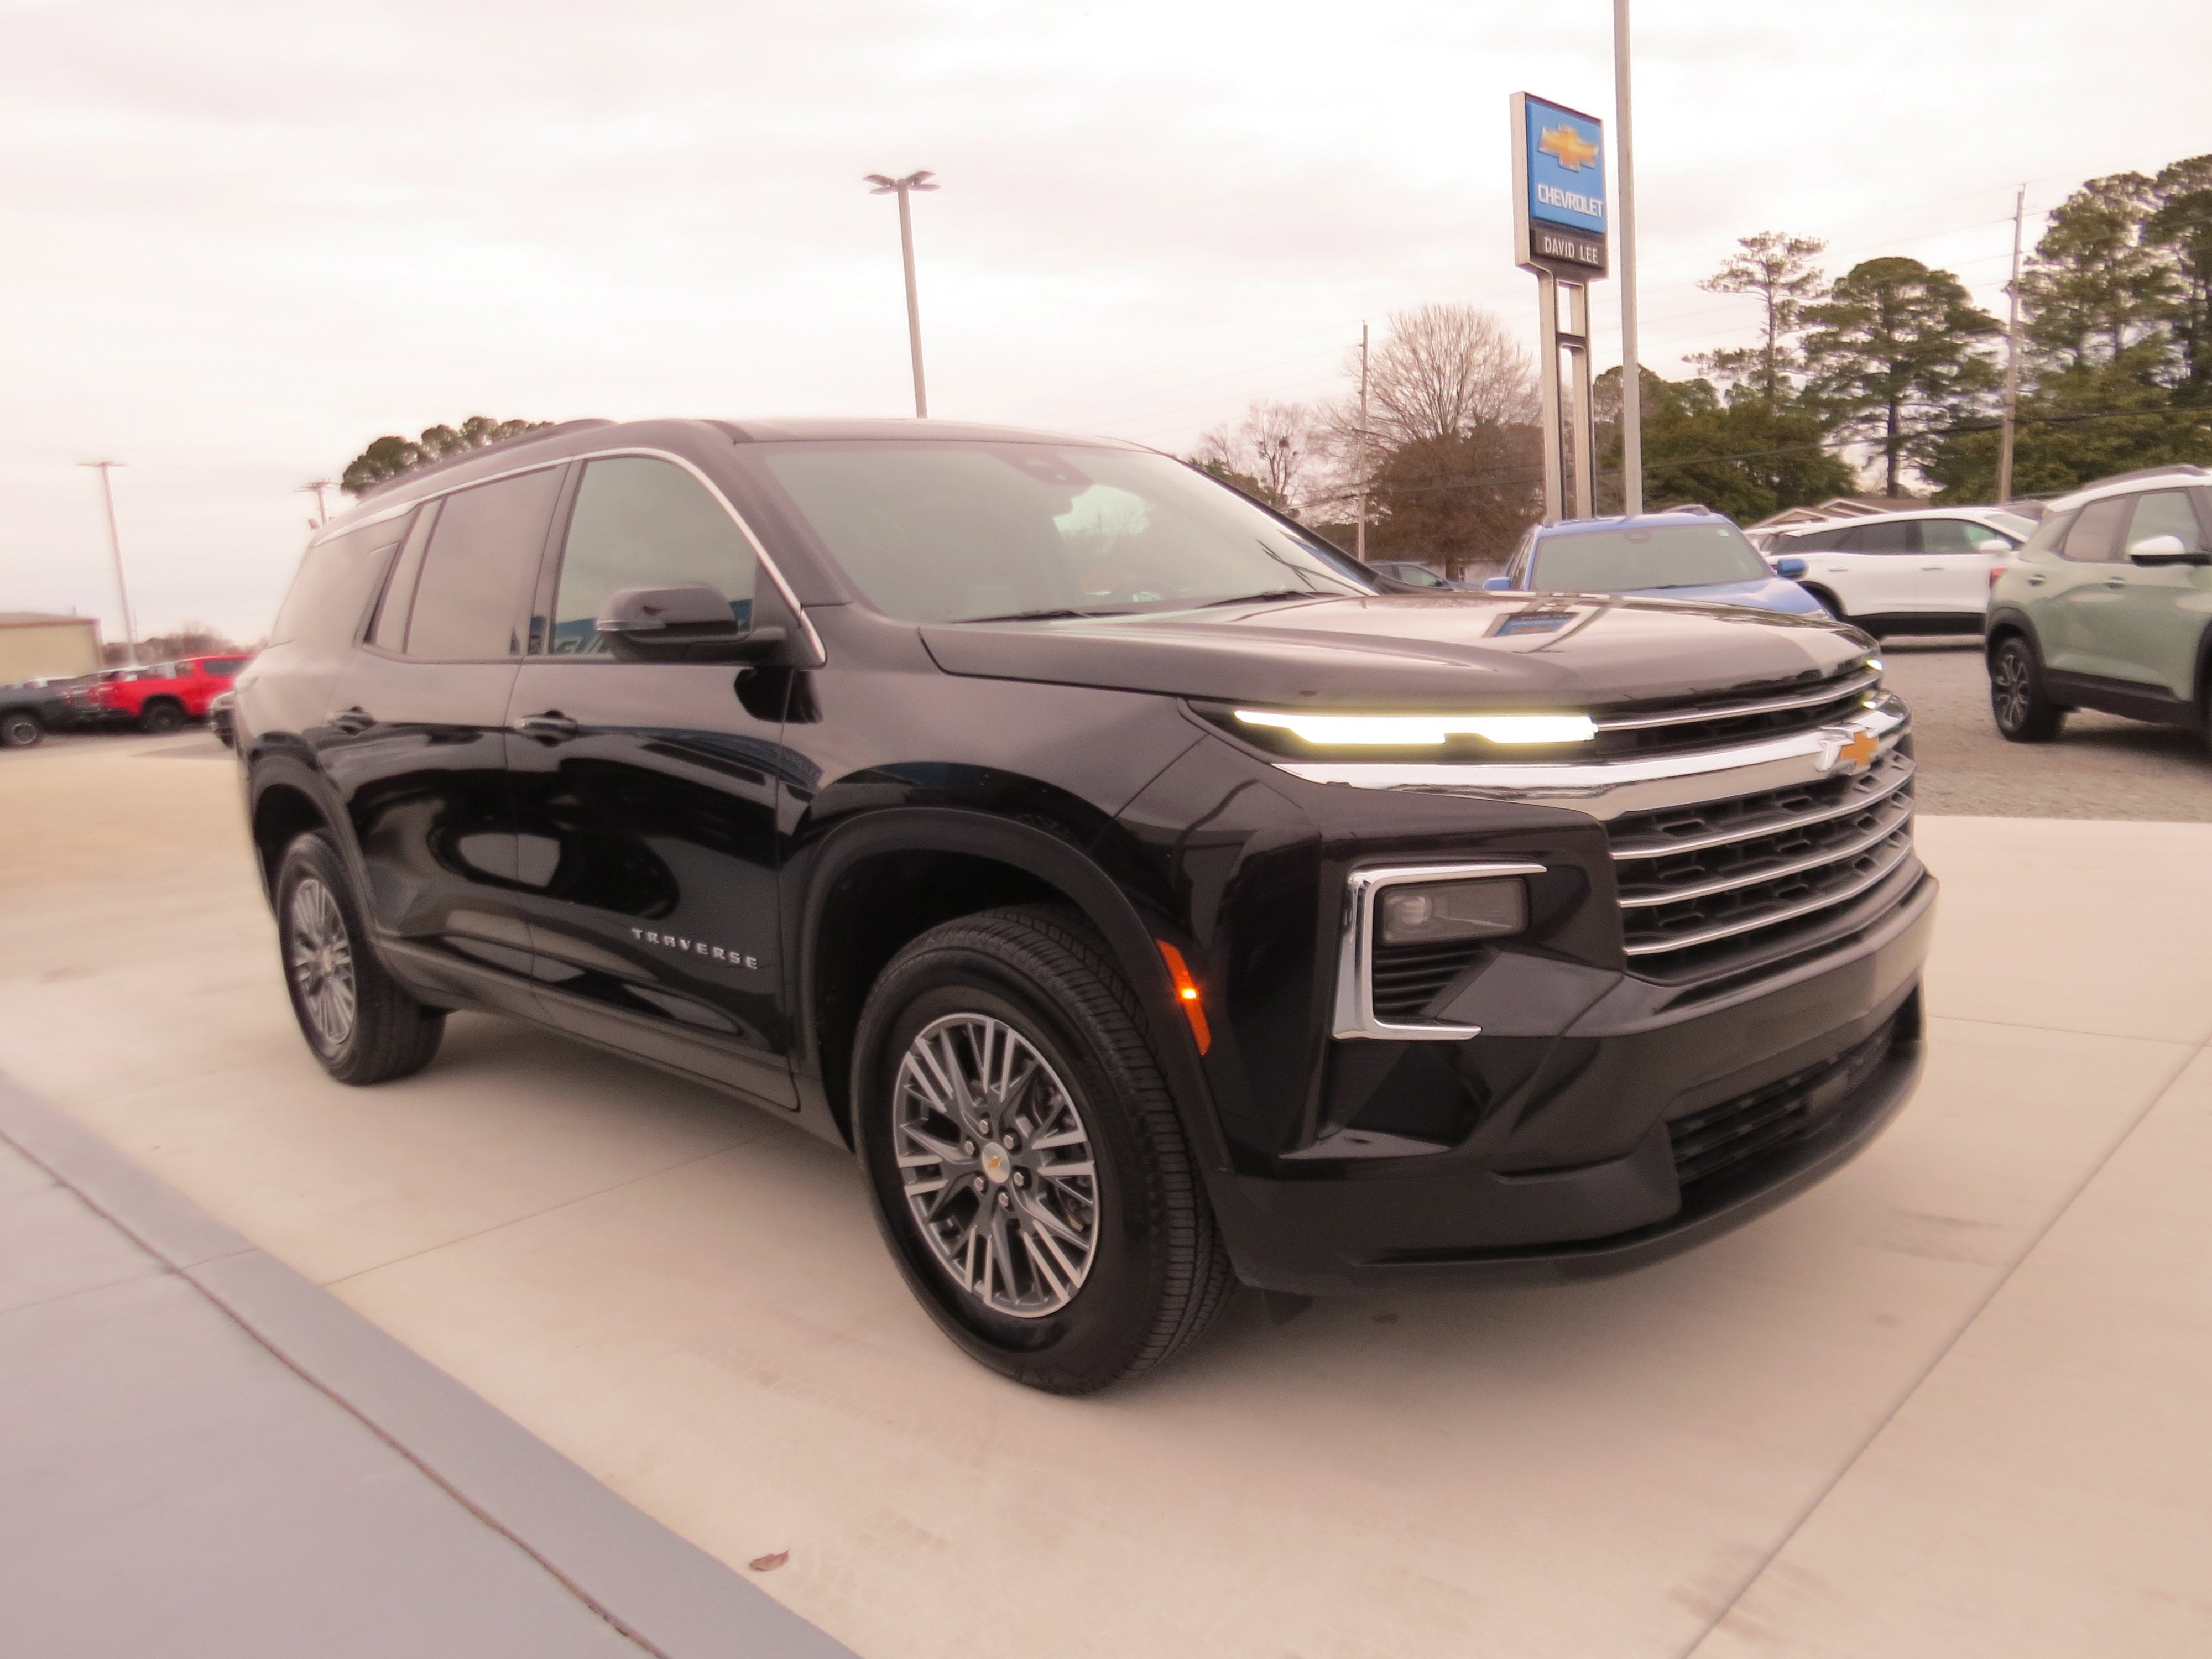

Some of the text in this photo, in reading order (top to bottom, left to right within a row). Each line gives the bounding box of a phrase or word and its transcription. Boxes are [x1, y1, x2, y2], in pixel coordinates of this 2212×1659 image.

[1538, 184, 1603, 217] CHEVROLET
[1545, 237, 1598, 264] DAVID LEE
[631, 928, 758, 969] TRAVERSE
